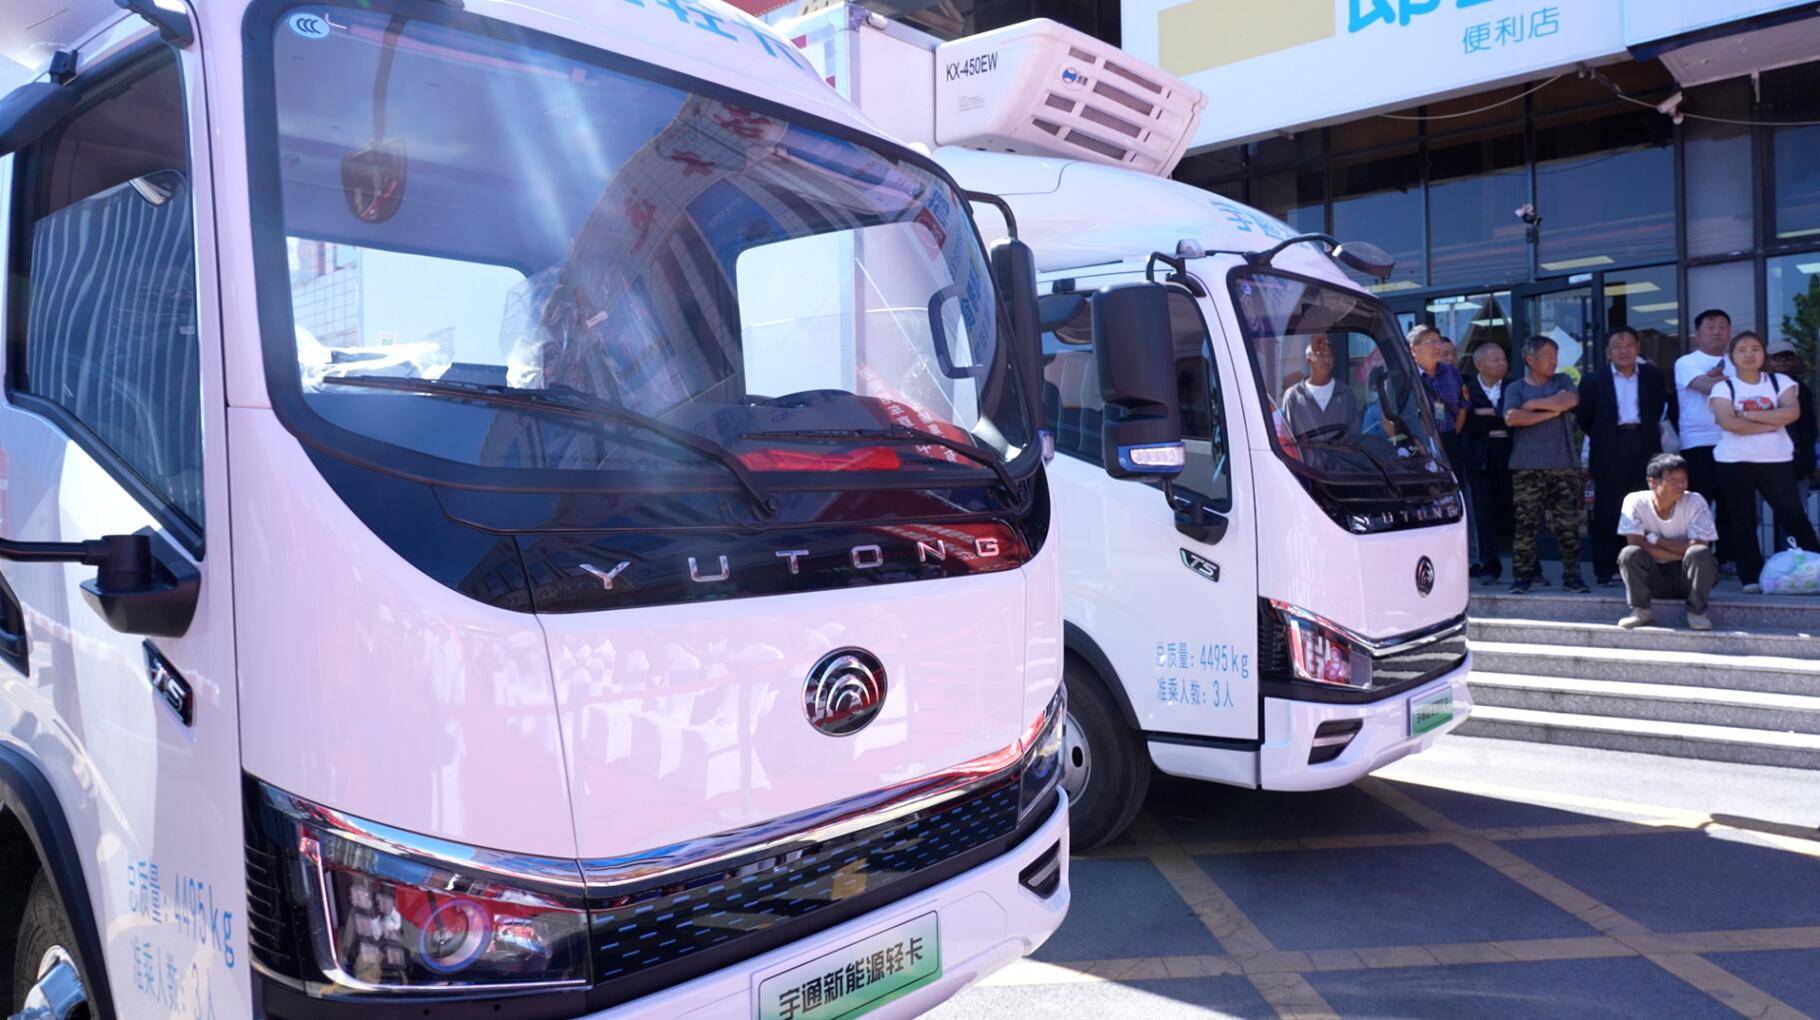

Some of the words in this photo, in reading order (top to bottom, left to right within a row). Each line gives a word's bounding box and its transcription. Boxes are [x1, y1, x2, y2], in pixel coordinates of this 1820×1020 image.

[1462, 6, 1560, 54] 便利店
[946, 52, 998, 81] KX-450EW
[579, 537, 1000, 590] YUTONG
[779, 937, 923, 1020] 宇通新能源轻卡
